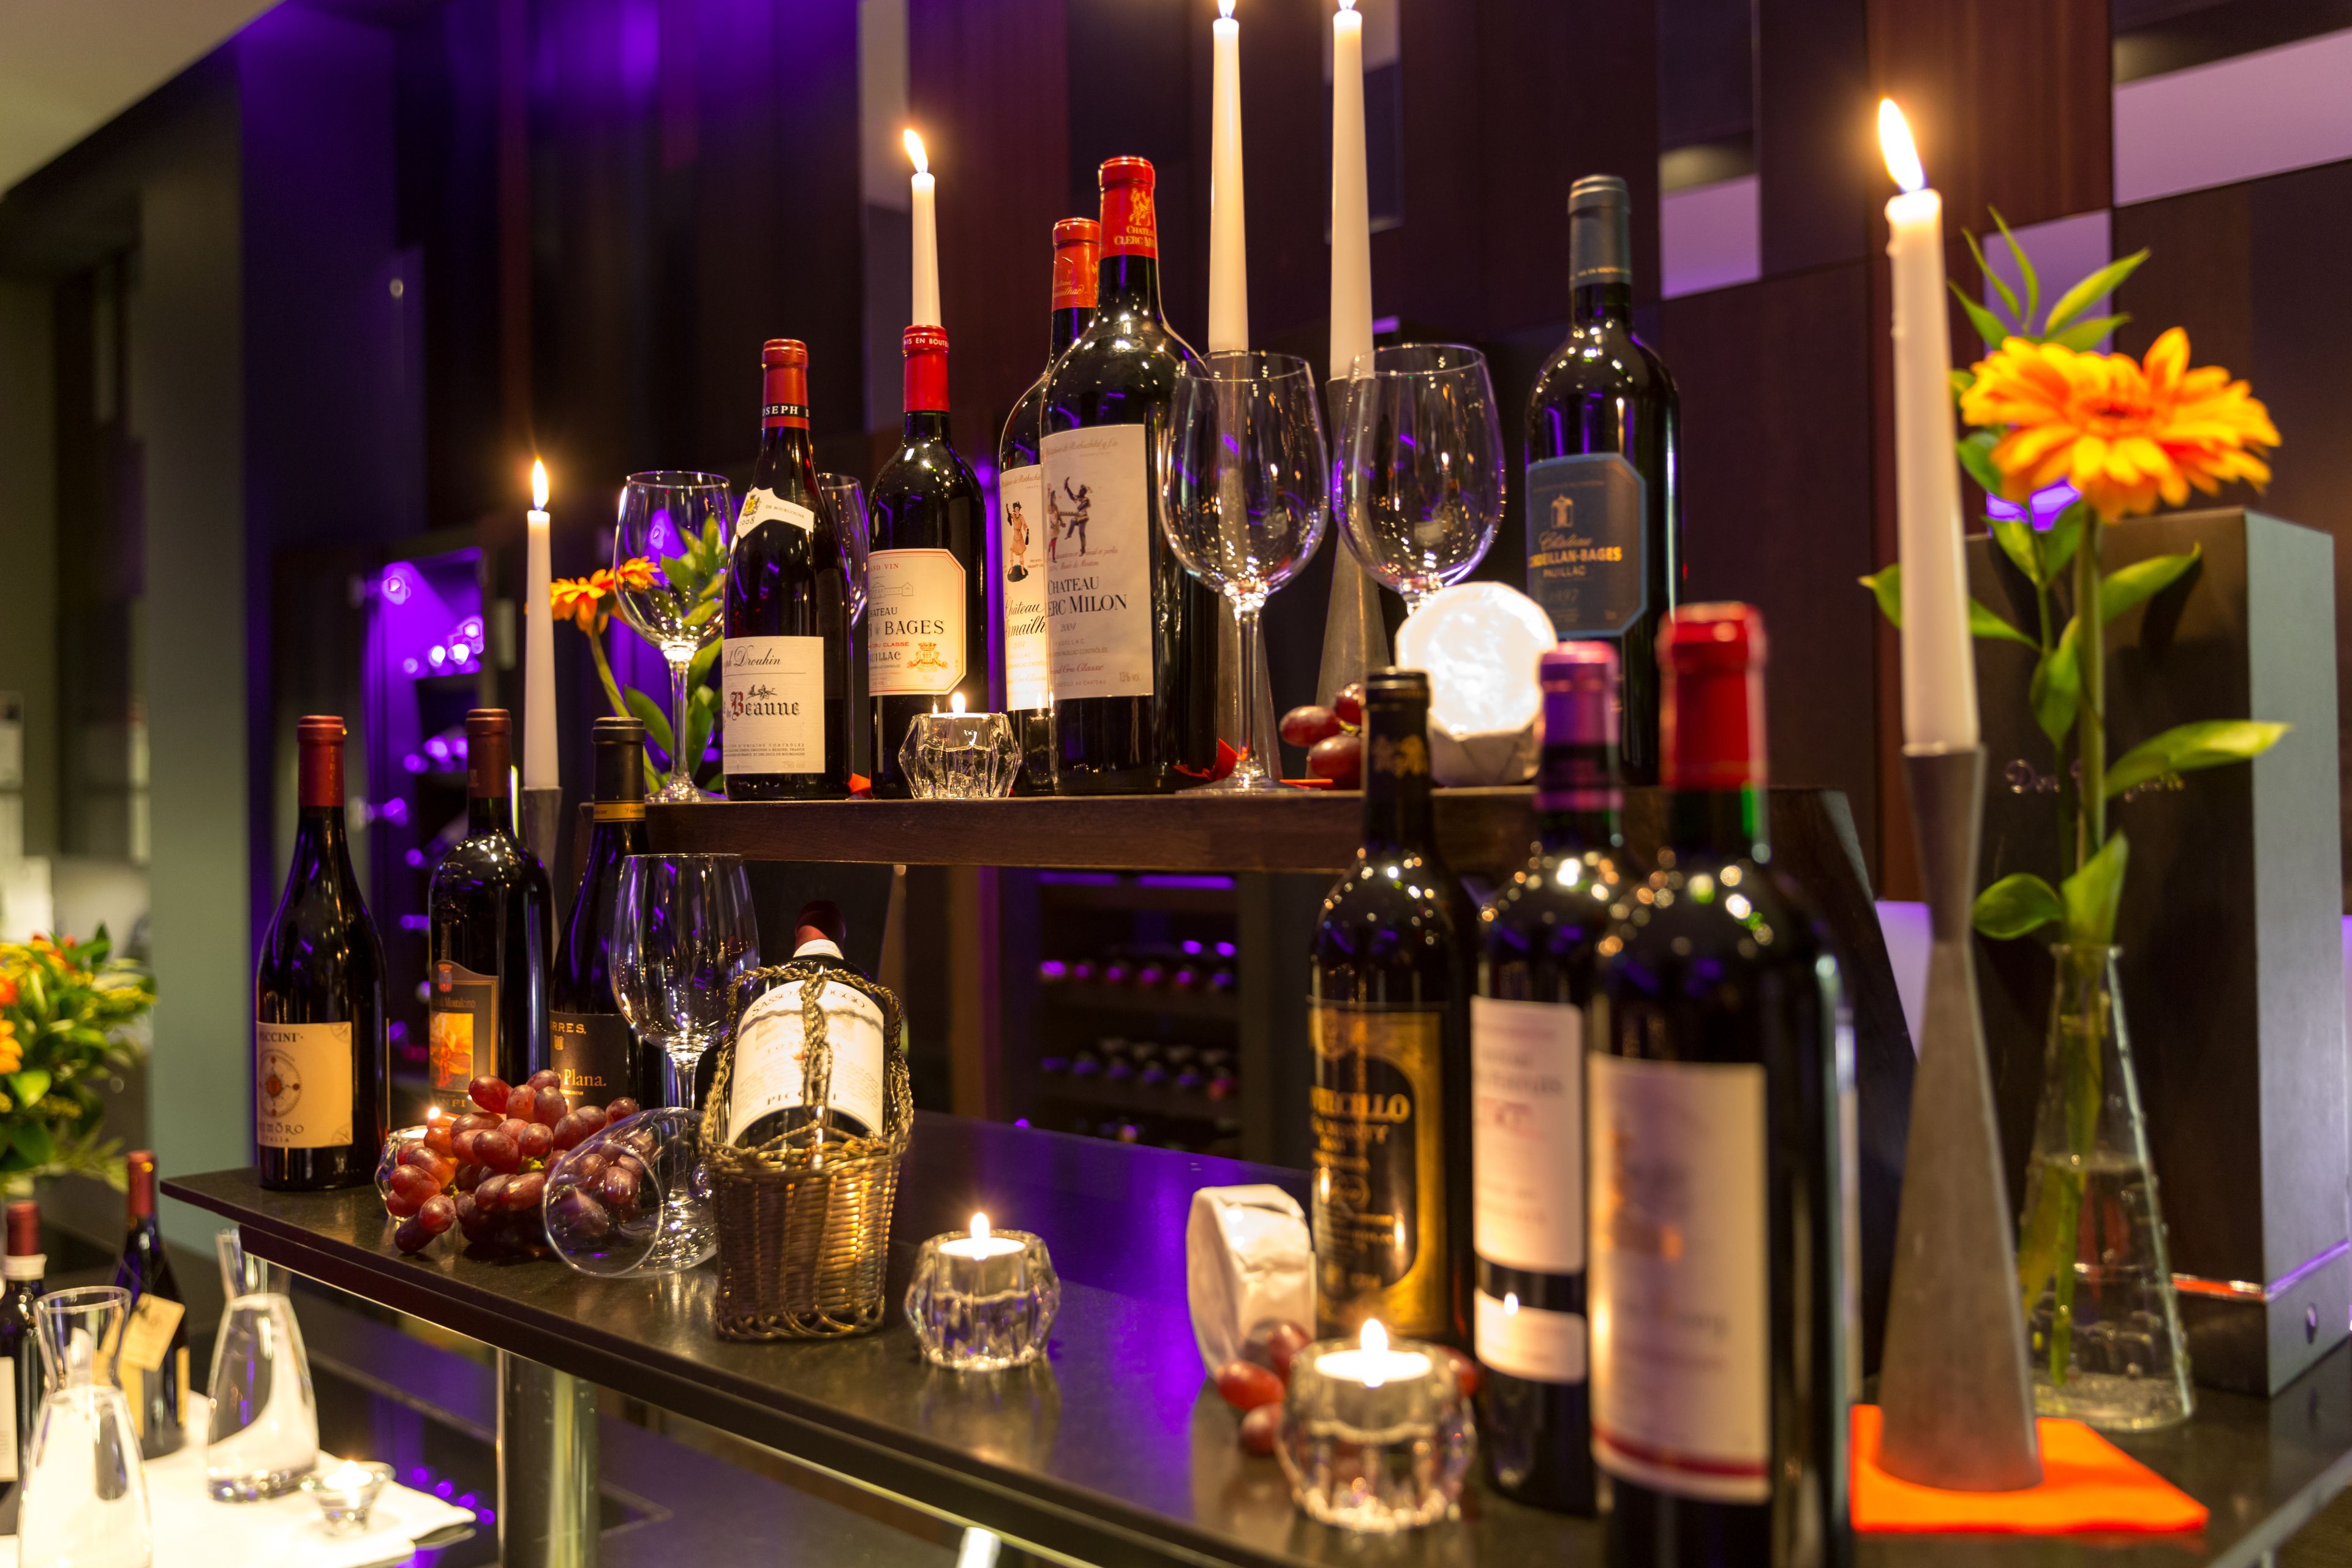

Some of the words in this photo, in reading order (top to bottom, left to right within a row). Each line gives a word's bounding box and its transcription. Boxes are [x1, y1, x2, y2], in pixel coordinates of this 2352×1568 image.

[1115, 236, 1143, 246] CLERC
[929, 338, 949, 348] BOUTE
[774, 506, 805, 519] BOURGOGNE
[1048, 576, 1099, 595] CHATEAU
[1005, 593, 1045, 619] Château
[1069, 594, 1128, 614] MILON
[884, 620, 945, 635] BAGES
[734, 645, 782, 667] Drouhin
[870, 651, 902, 663] UILLAC
[730, 692, 801, 721] Beaune
[259, 1031, 296, 1042] CCINI
[564, 1068, 607, 1087] Plana.
